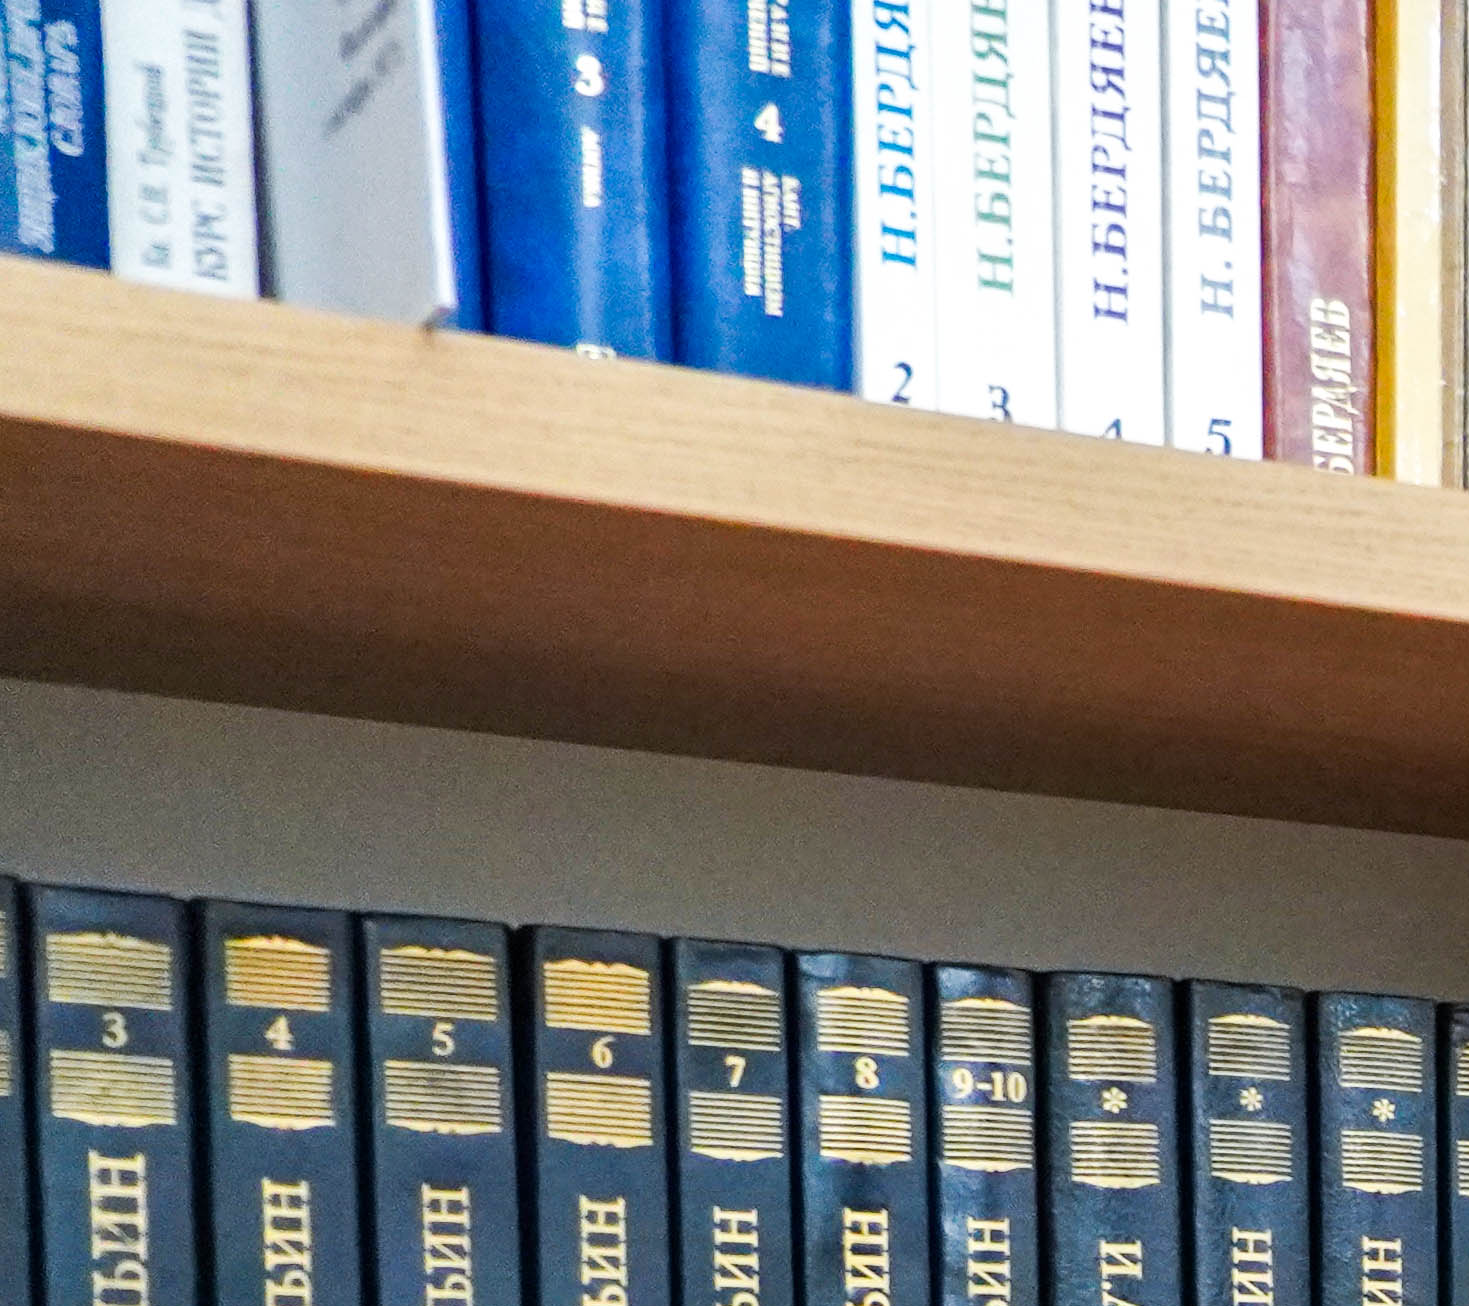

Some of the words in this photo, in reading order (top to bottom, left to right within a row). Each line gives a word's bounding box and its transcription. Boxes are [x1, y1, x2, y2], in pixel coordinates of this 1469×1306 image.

[575, 56, 605, 97] 3
[754, 103, 782, 143] 4
[891, 361, 914, 406] 2
[1309, 297, 1355, 476] БЕРДЯЕВ
[1205, 418, 1233, 456] 5
[101, 1015, 129, 1049] 3
[266, 1018, 292, 1050] 4
[432, 1024, 454, 1056] 5
[591, 1037, 615, 1068] 6
[725, 1056, 746, 1088] 7
[855, 1059, 879, 1088] 8
[951, 1071, 1028, 1104] 9-10
